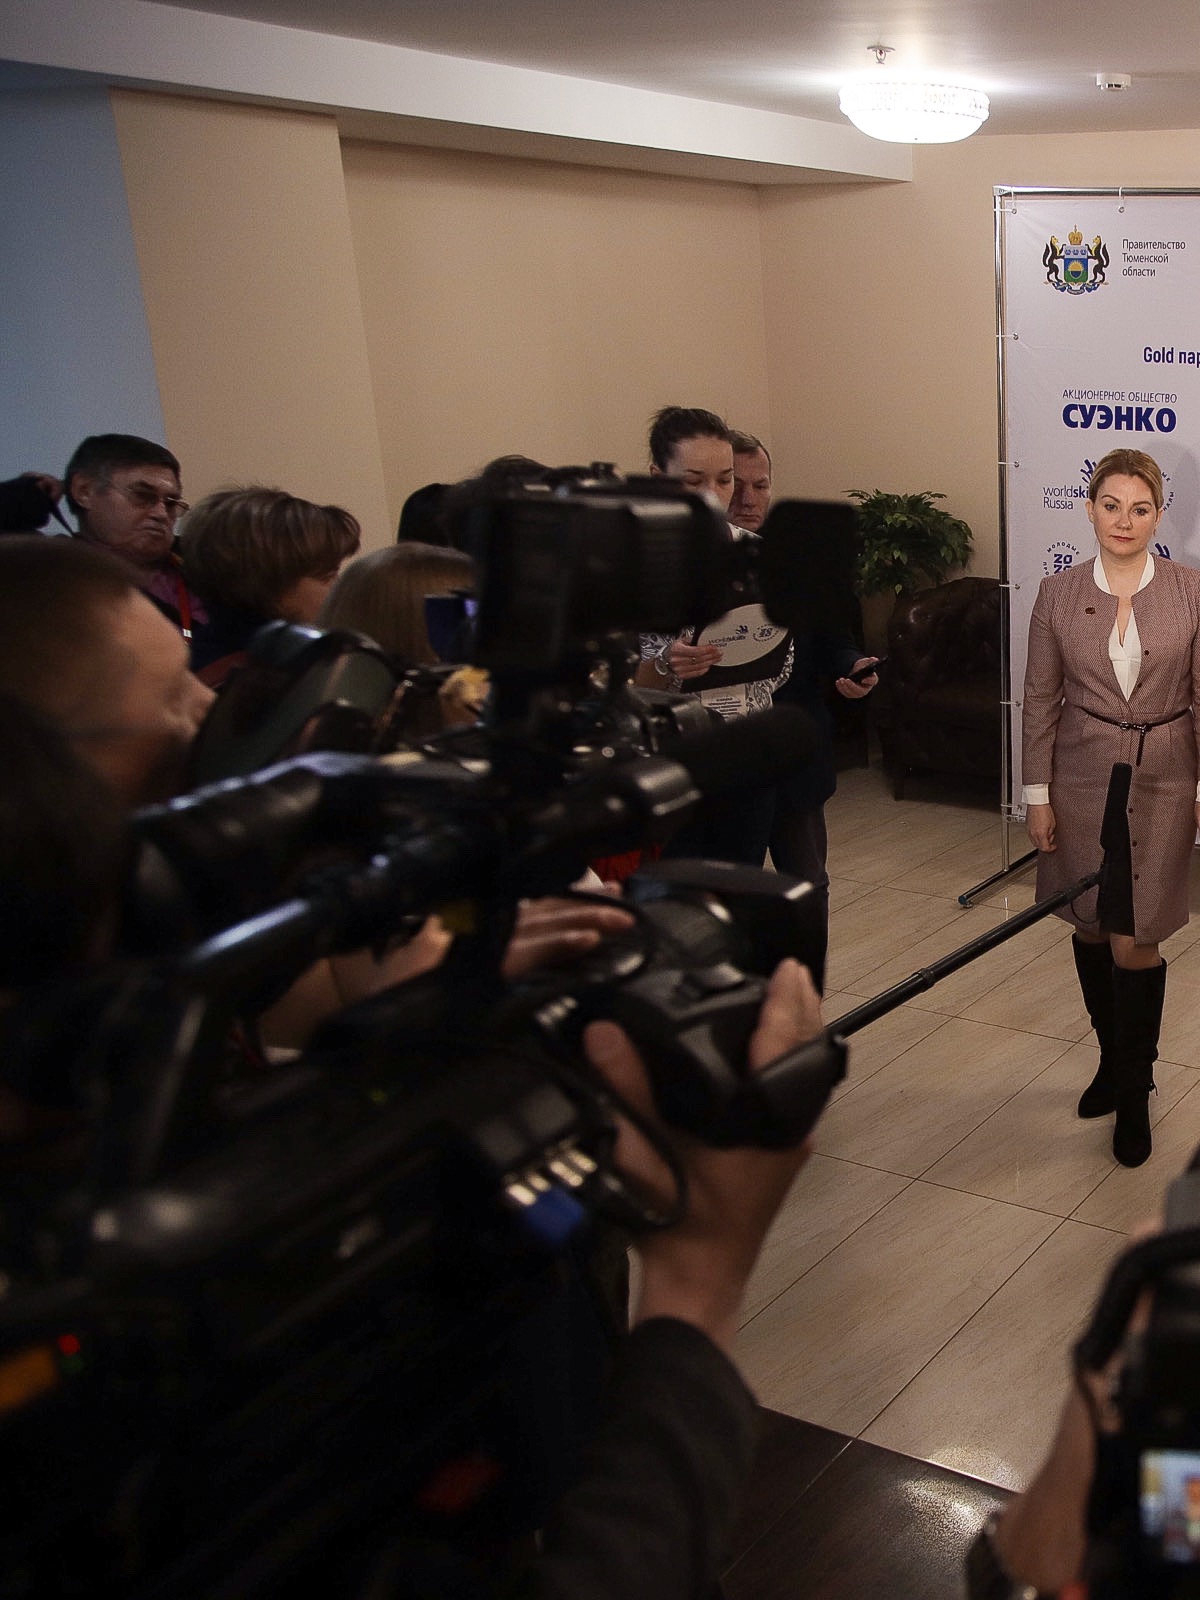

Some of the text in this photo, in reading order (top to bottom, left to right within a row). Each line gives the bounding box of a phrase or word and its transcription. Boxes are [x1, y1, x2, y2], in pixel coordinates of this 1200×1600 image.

[1122, 239, 1186, 251] Правительство
[1122, 253, 1169, 264] Тюменской
[1122, 266, 1156, 277] области
[1143, 347, 1174, 364] Gold
[1062, 389, 1177, 404] АКЦИОНЕРНОЕ ОБЩЕСТВО
[1062, 403, 1177, 433] СУЭНКО
[1043, 485, 1089, 498] worldski
[1043, 497, 1074, 510] Russia
